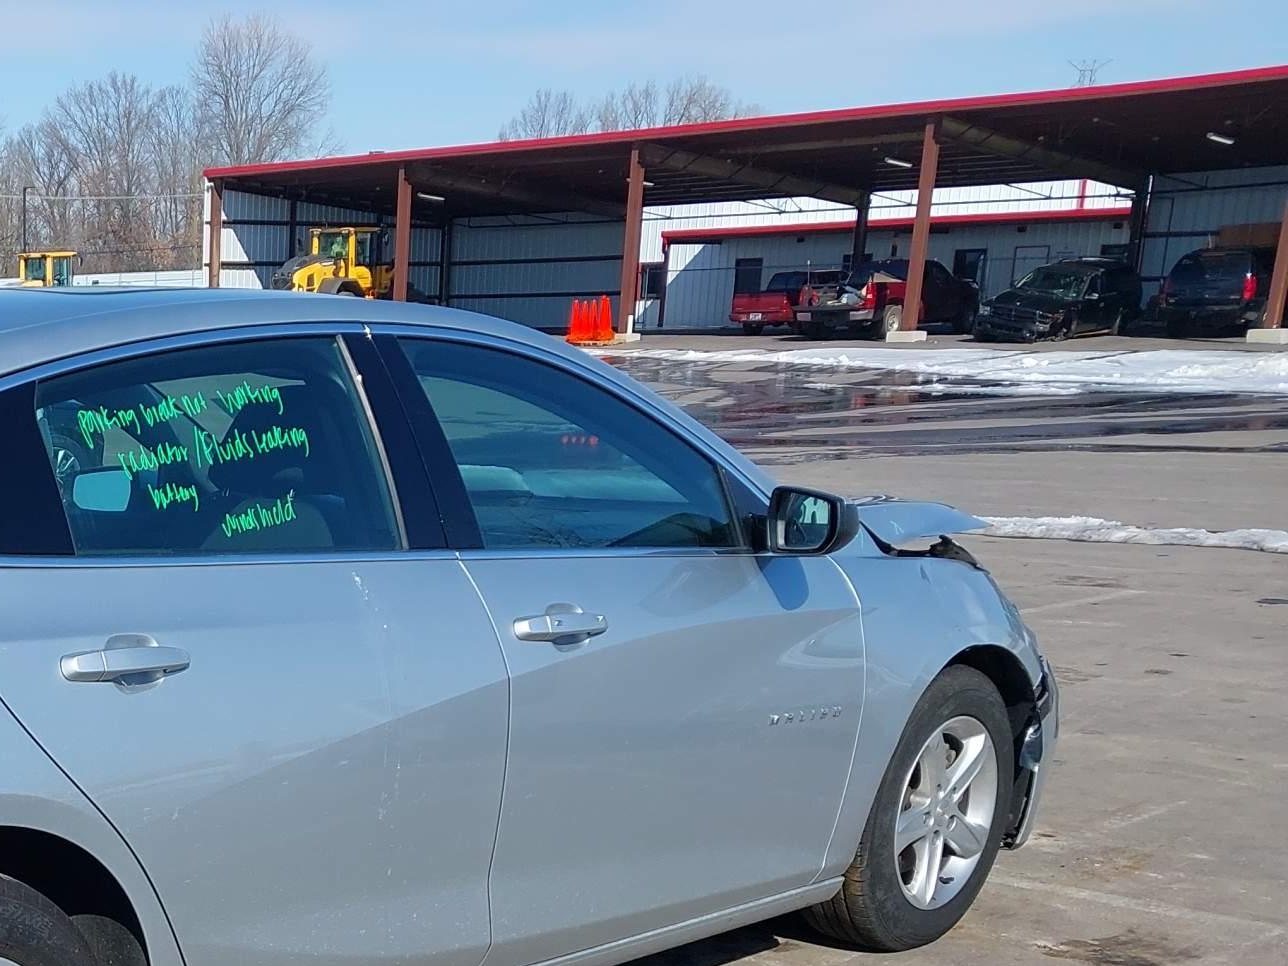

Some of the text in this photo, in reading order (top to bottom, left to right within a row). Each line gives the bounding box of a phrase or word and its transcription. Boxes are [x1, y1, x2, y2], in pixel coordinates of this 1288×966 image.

[182, 392, 208, 418] not
[217, 380, 284, 415] working
[118, 441, 188, 480] radiator
[148, 483, 200, 512] battery
[221, 494, 297, 538] windshield
